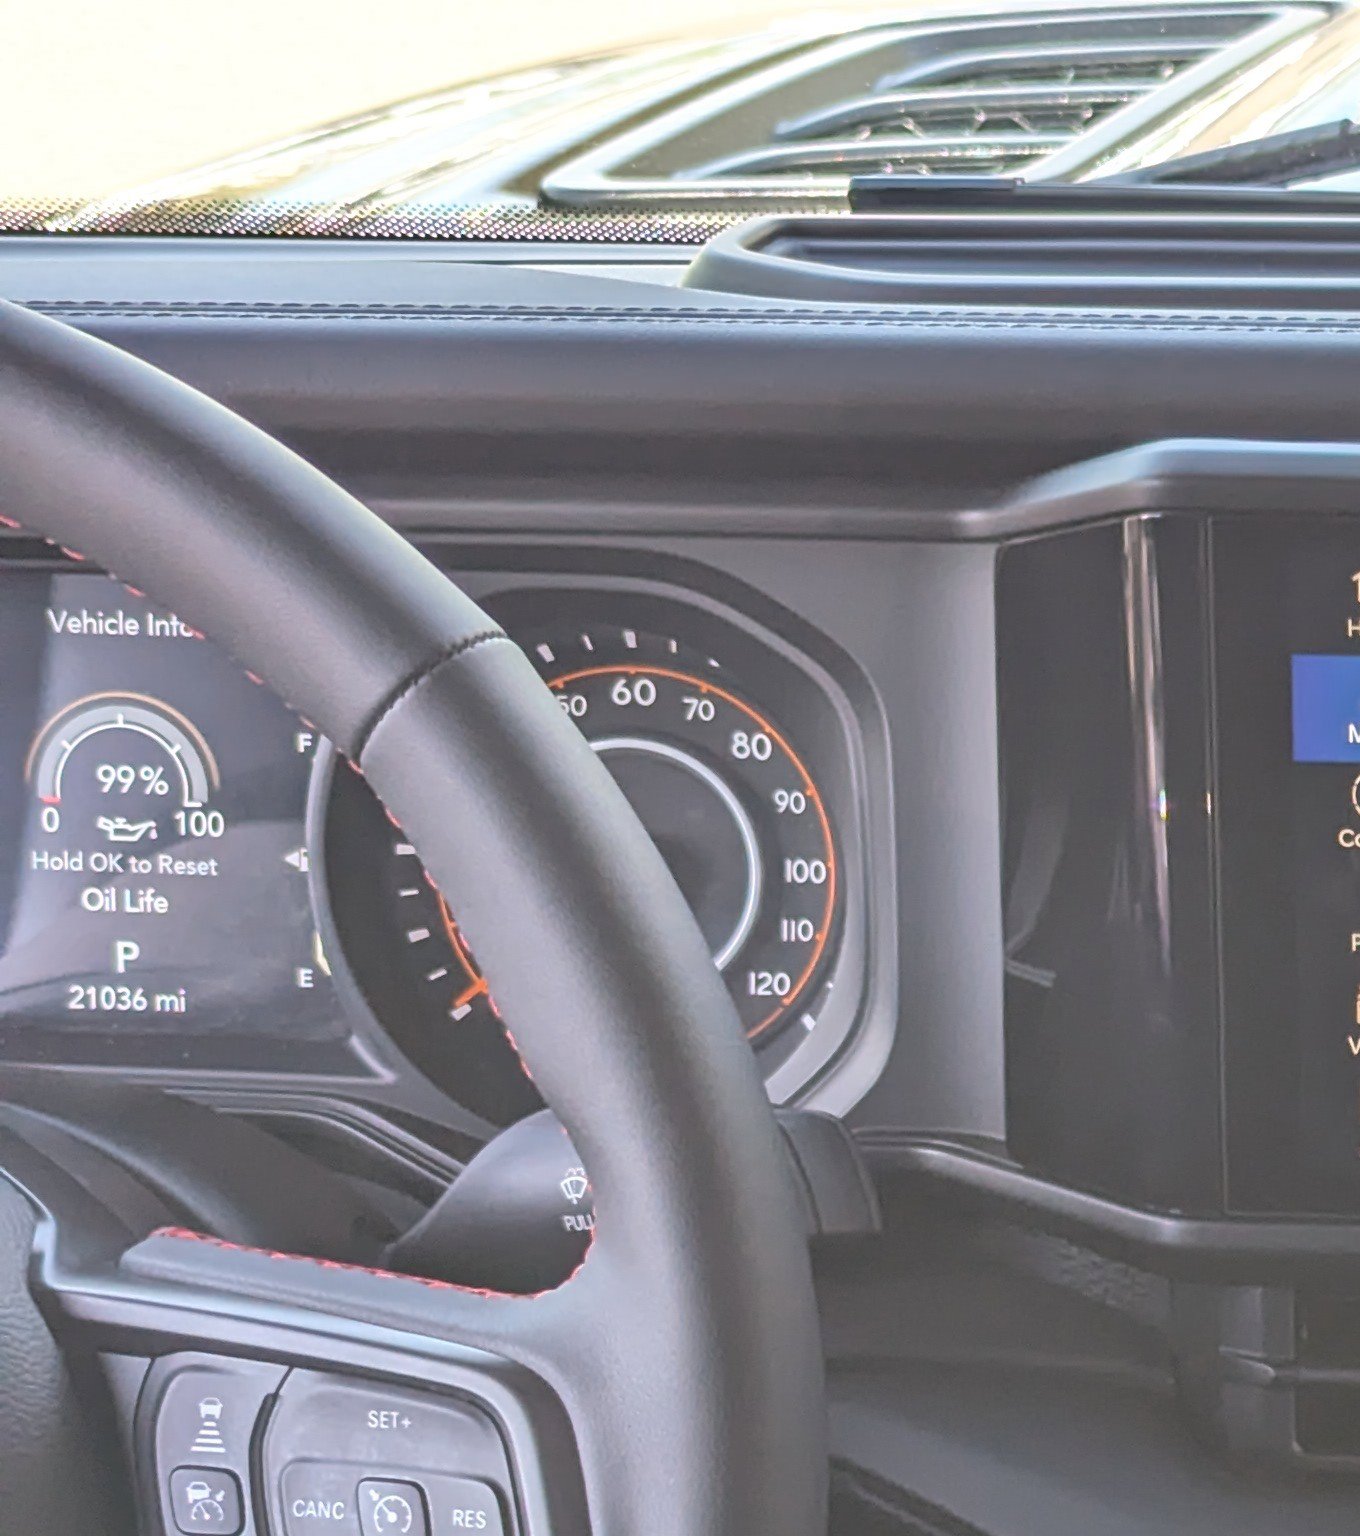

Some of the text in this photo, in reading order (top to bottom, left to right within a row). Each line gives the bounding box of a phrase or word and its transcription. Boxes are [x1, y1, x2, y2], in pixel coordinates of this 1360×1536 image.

[47, 608, 140, 636] Vehicle
[611, 678, 657, 706] 60
[683, 697, 716, 722] 70
[297, 733, 312, 753] F
[732, 731, 773, 762] 80
[96, 765, 169, 796] 99%
[774, 788, 806, 816] 90
[40, 807, 60, 834] 0
[174, 810, 225, 839] 100
[31, 851, 218, 877] Hold OK to Reset
[784, 857, 827, 884] 100
[81, 887, 170, 914] Oil Life
[781, 918, 814, 943] 110
[116, 940, 141, 974] P
[298, 967, 315, 988] E
[749, 972, 791, 997] 120
[67, 984, 187, 1014] 21036 mi
[292, 1501, 345, 1519] CANC
[452, 1510, 486, 1529] RES
